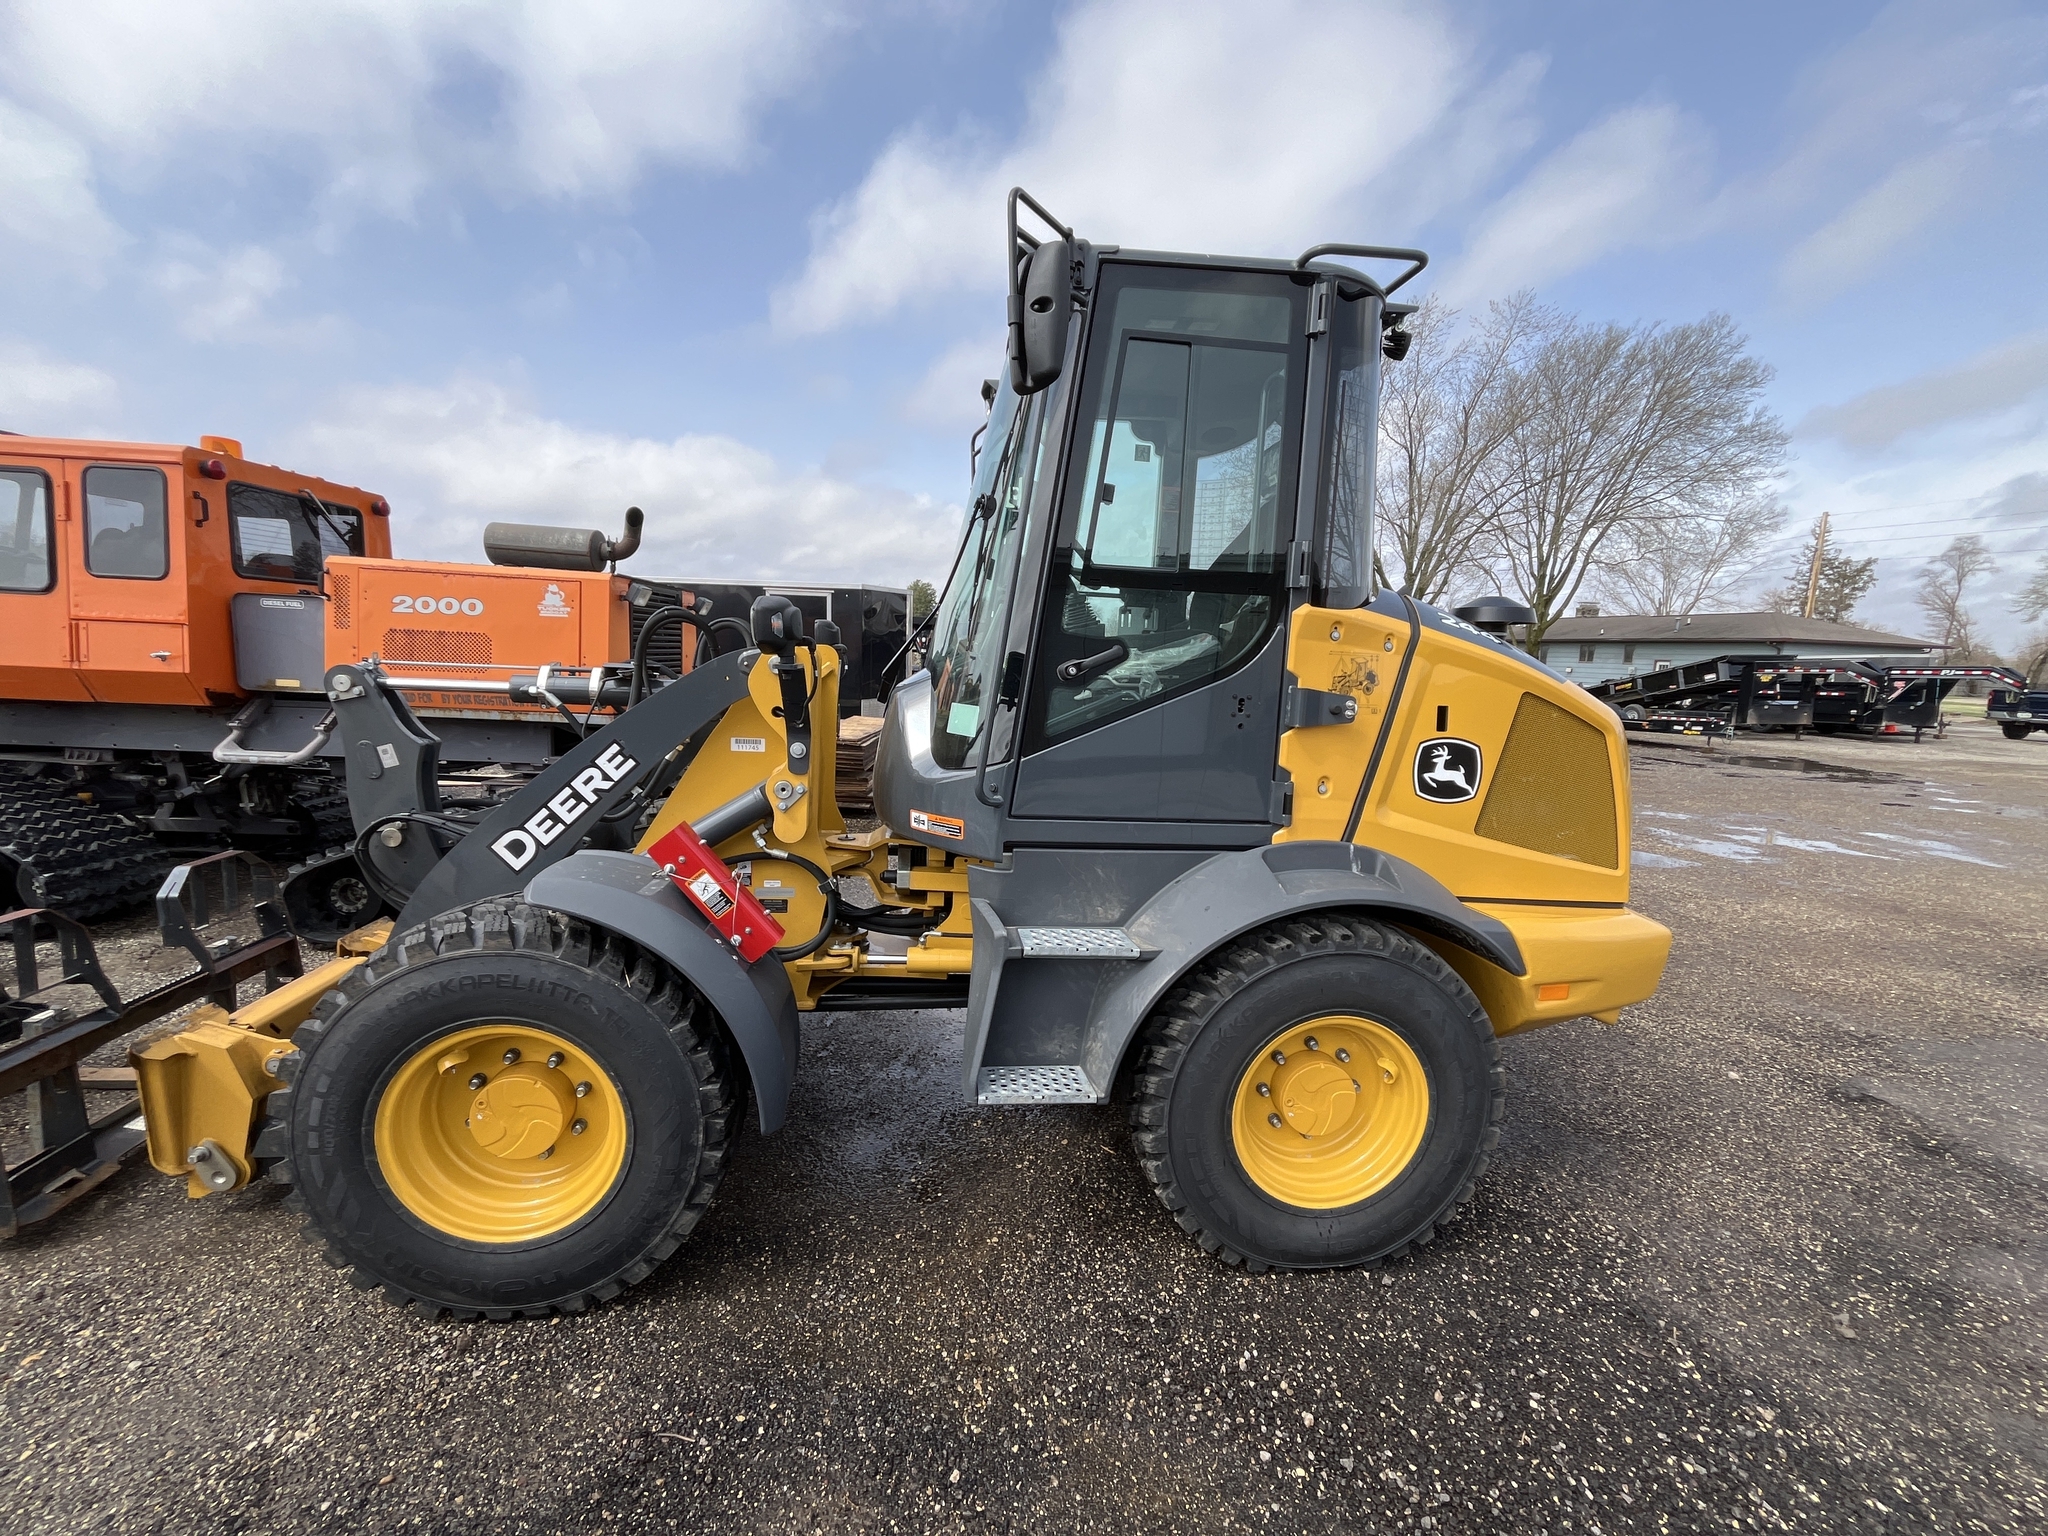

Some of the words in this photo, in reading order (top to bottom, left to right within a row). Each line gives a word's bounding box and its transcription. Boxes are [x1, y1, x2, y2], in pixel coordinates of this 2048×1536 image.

[391, 595, 484, 616] 2000
[417, 693, 433, 703] FOR
[441, 694, 450, 704] BY
[452, 694, 473, 705] YOUR
[489, 741, 638, 873] DEERE
